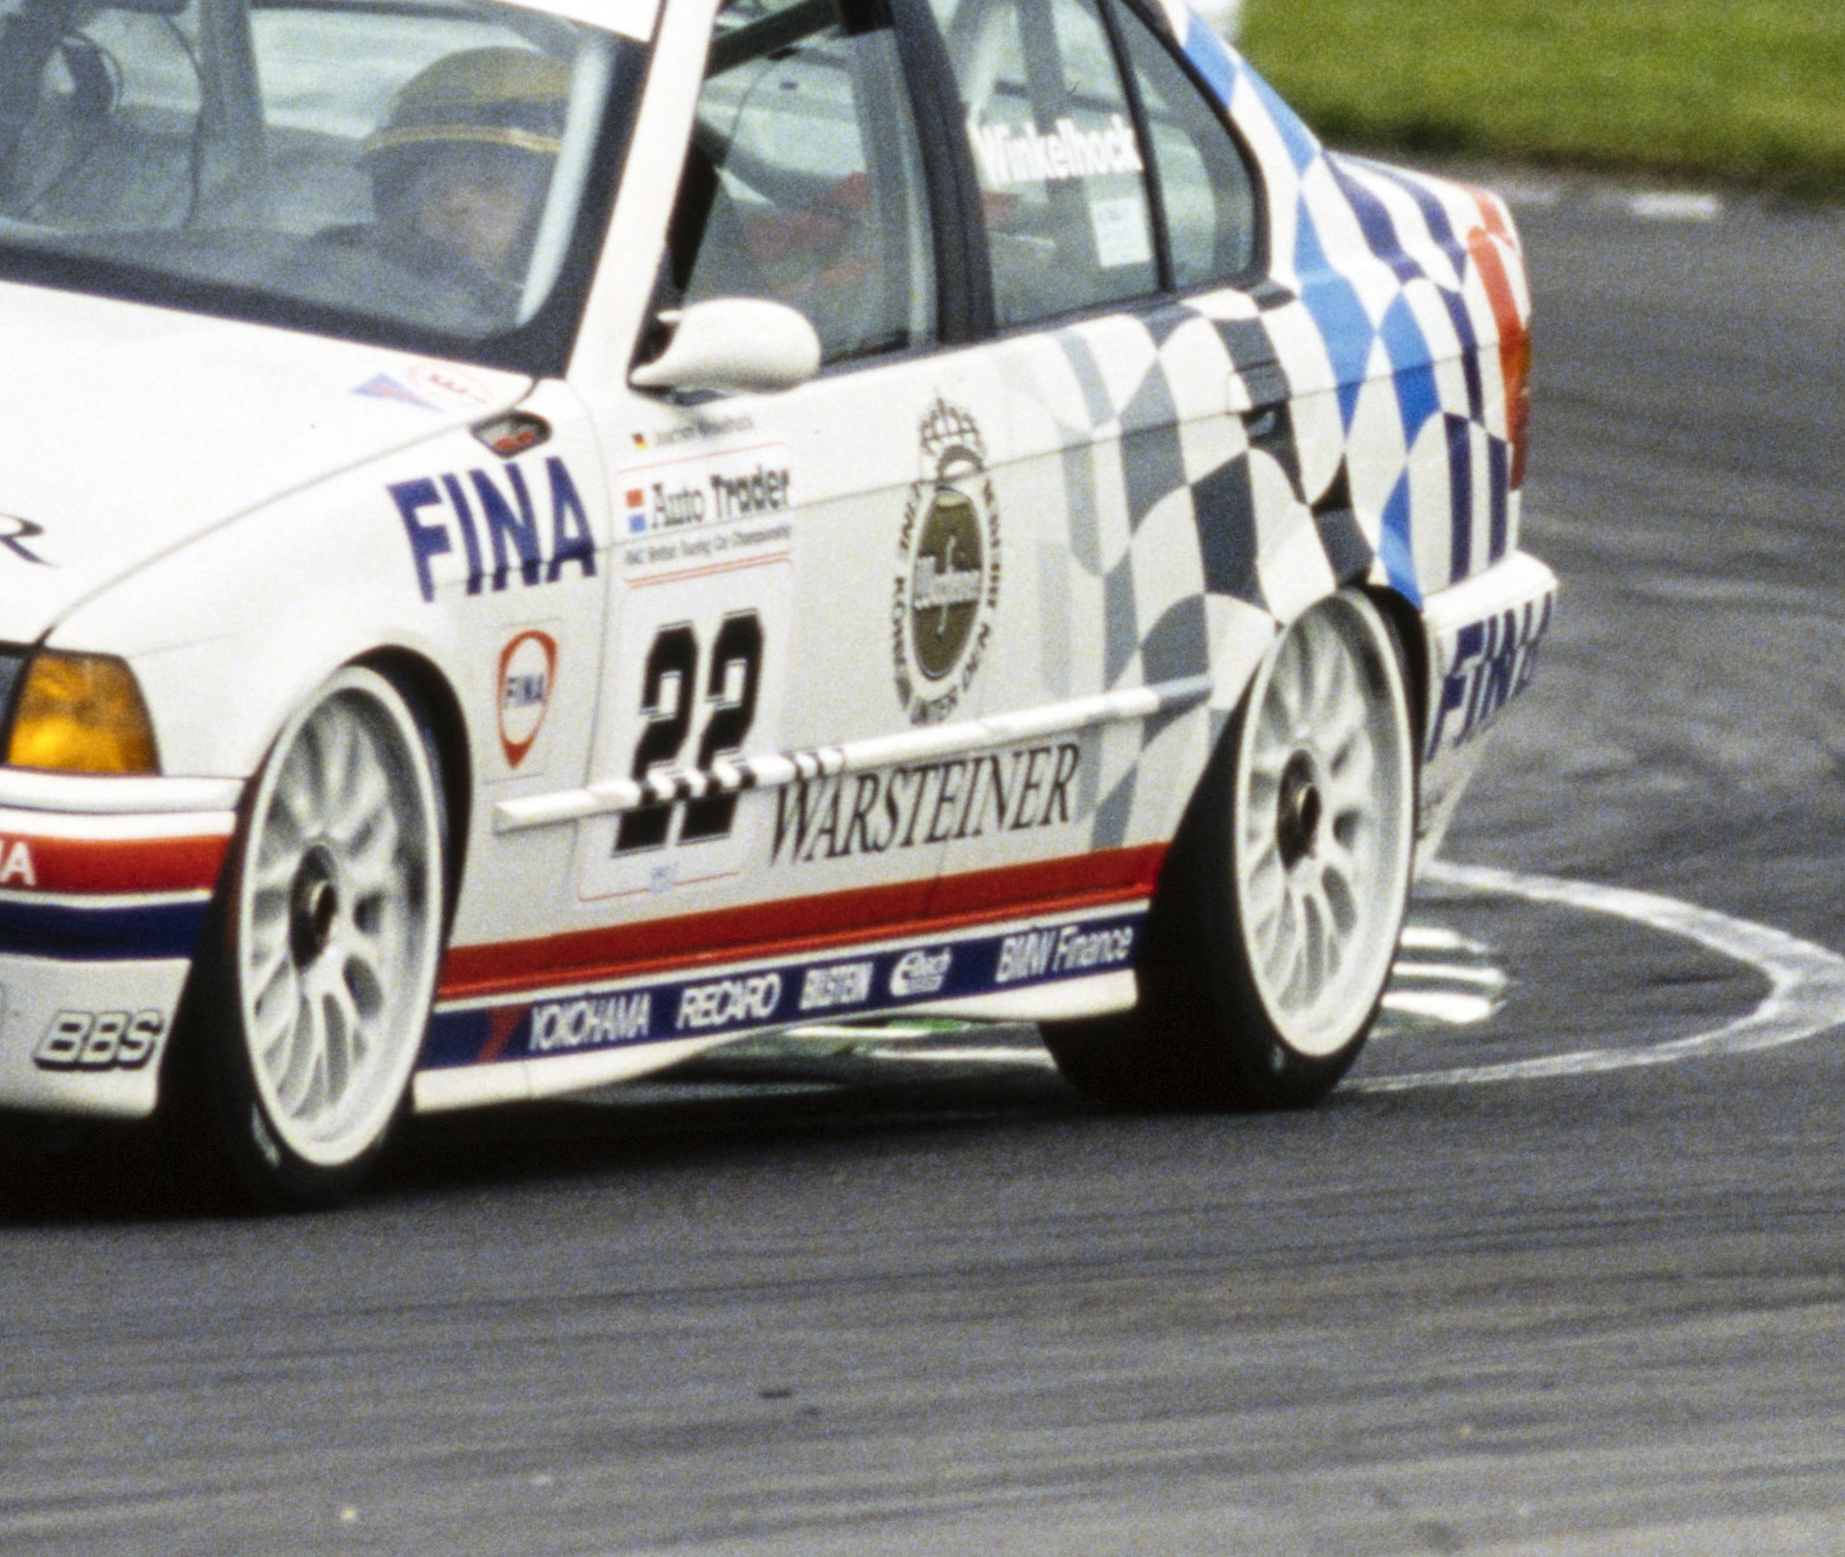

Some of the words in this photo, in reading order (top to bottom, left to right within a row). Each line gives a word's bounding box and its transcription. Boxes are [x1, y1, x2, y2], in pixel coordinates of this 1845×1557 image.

[967, 112, 1145, 190] Winkelhock
[386, 456, 597, 603] FINA
[651, 481, 704, 531] Auto
[710, 463, 790, 521] Trader
[503, 674, 547, 708] FINA
[609, 605, 766, 860] 22
[1422, 593, 1553, 764] FINA
[767, 743, 1082, 867] WARSTEINER
[33, 1011, 164, 1072] BBS
[528, 993, 651, 1051] YOKOHAMA
[675, 973, 782, 1030] RECARO
[995, 930, 1057, 984] BMW
[1052, 924, 1135, 973] Finance
